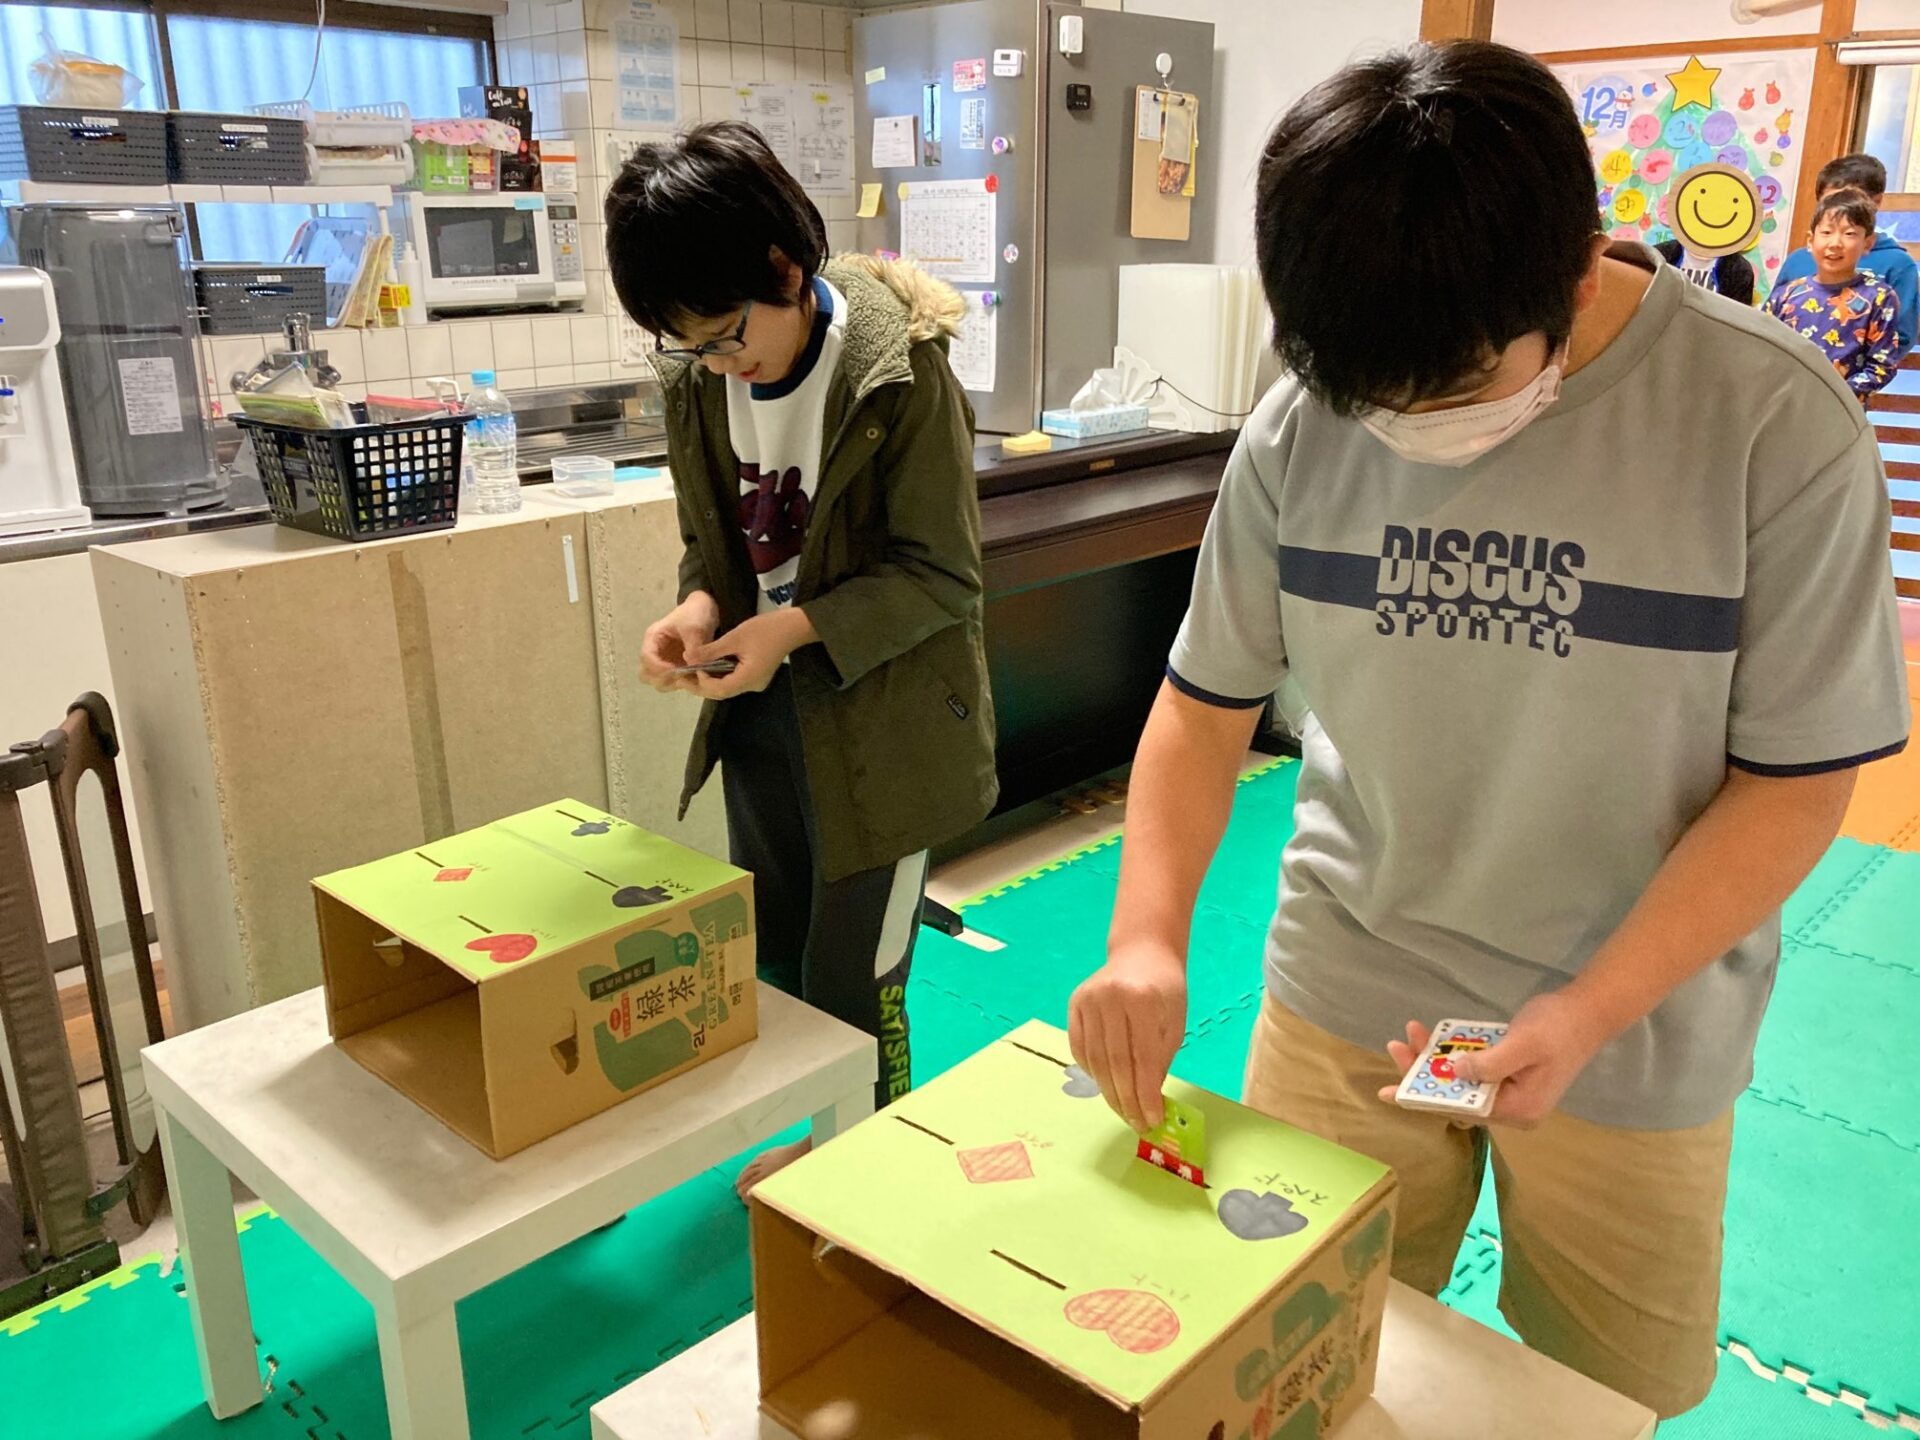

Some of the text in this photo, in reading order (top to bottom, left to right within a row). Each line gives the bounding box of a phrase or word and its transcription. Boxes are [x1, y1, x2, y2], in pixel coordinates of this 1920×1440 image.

[1582, 87, 1627, 128] 12月
[1376, 524, 1585, 616] DISCUS
[1376, 599, 1574, 658] SPORTEC
[636, 974, 696, 1022] 緑茶
[693, 1024, 706, 1049] 2L
[880, 984, 910, 1102] SATISFIE
[1253, 1171, 1330, 1206] スペード
